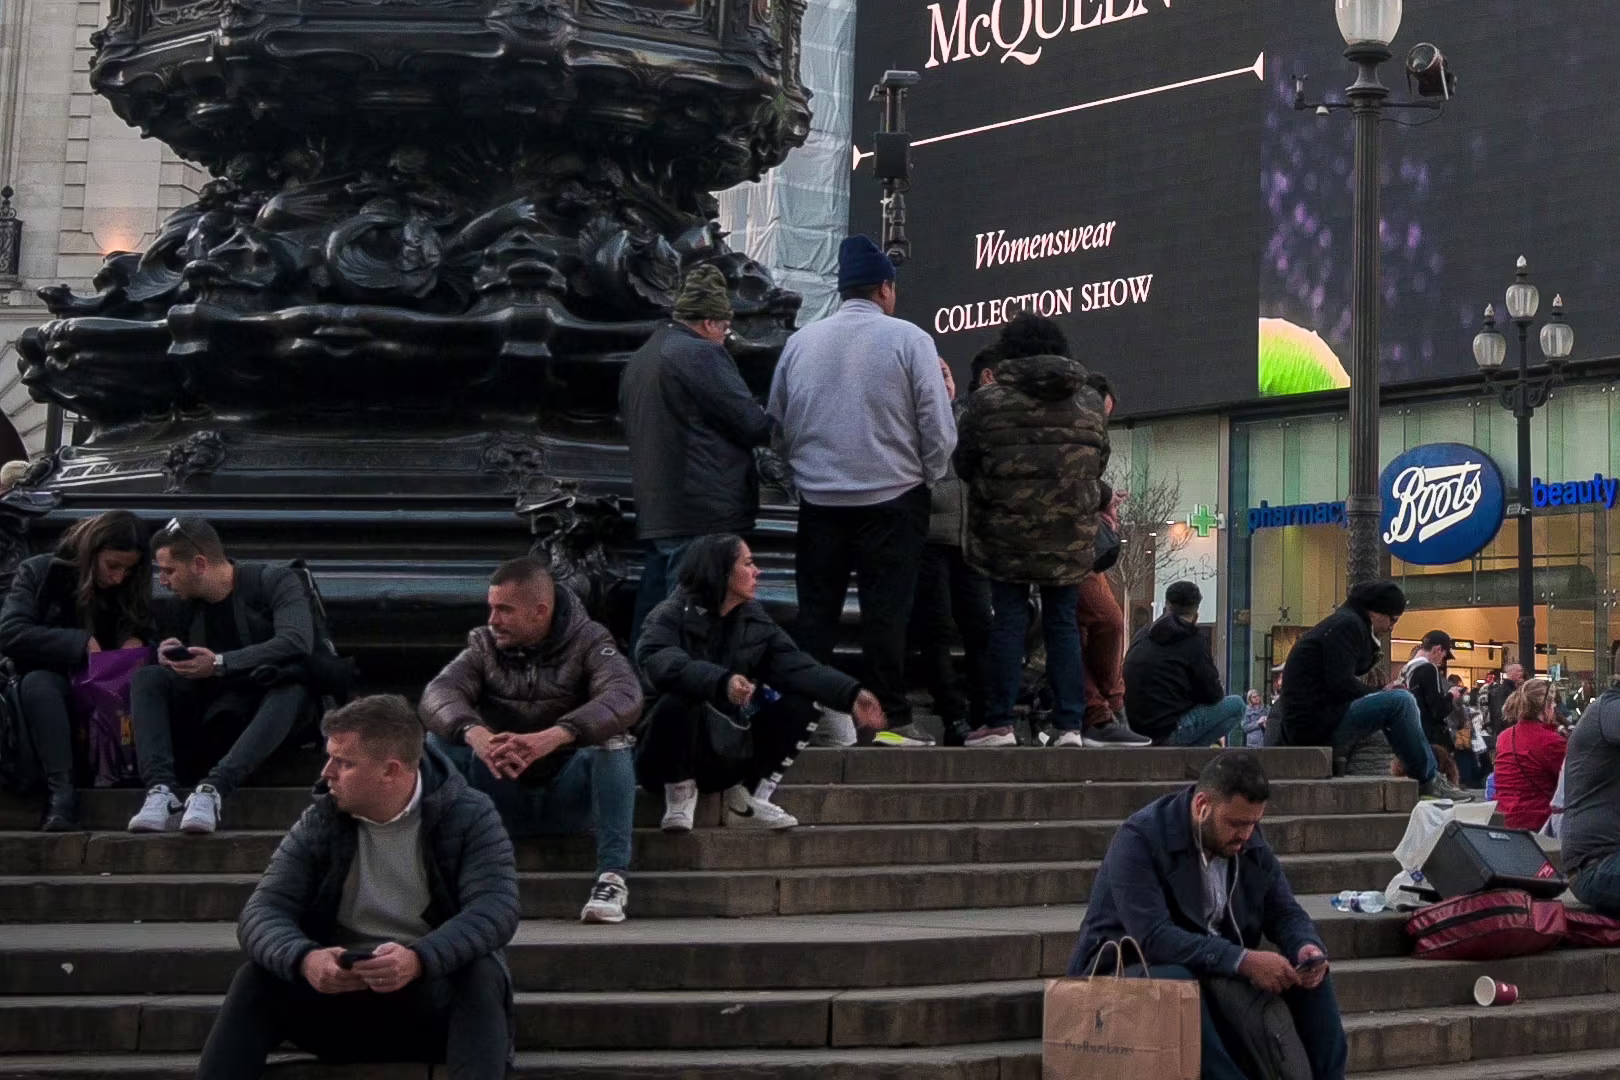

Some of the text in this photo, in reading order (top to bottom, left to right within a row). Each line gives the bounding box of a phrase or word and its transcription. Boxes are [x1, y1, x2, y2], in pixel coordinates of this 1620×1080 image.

[975, 220, 1117, 270] Womenswear
[934, 274, 1154, 334] COLLECTION SHOW
[1383, 461, 1482, 544] Boots
[1531, 473, 1619, 508] beauty
